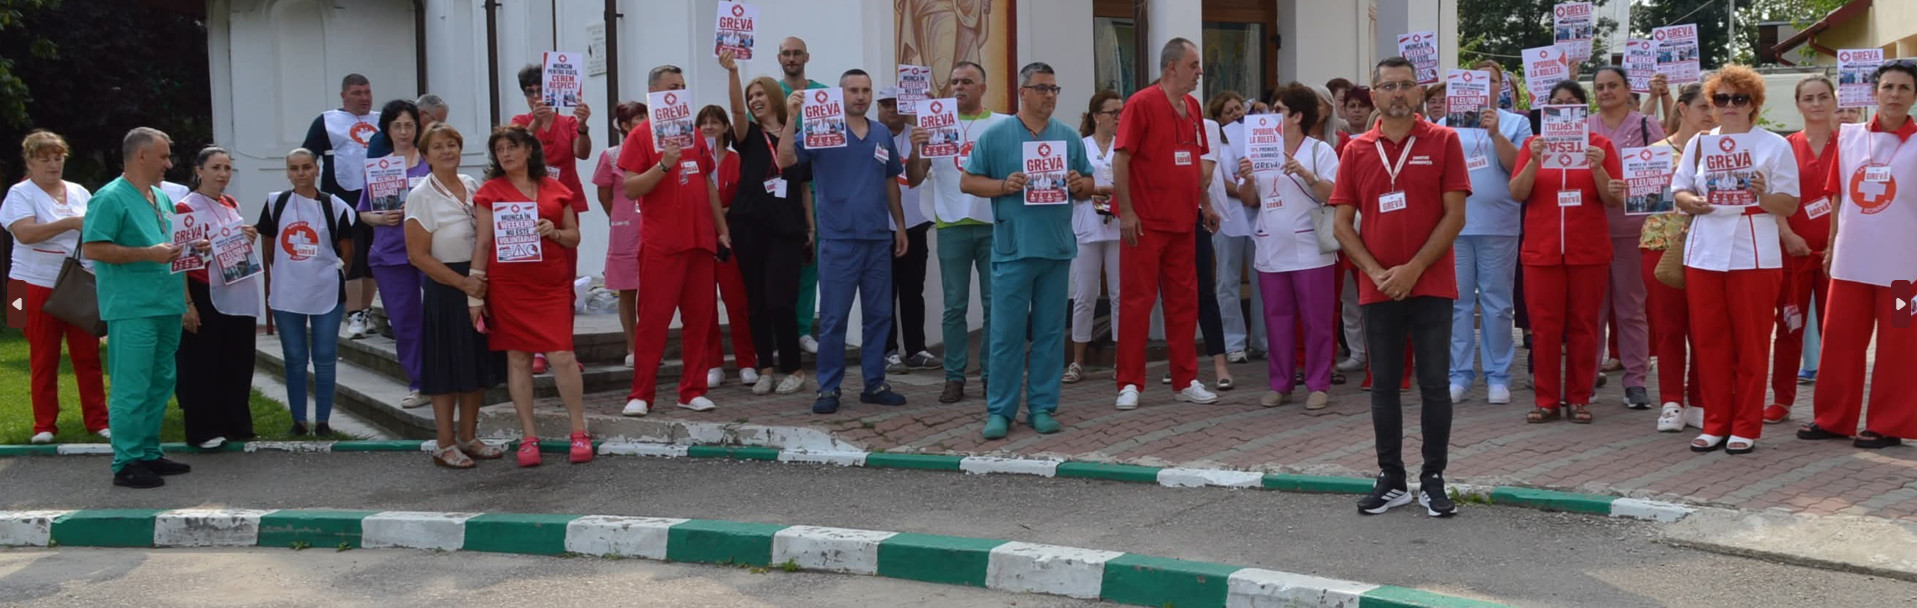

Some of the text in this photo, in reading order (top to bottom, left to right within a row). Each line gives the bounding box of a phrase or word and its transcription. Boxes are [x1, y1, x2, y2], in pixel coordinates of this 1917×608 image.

[720, 16, 753, 30] GREVĂ
[655, 102, 690, 120] GREVĂ
[805, 100, 840, 118] GREVĂ
[921, 111, 955, 128] GREVĂ
[1027, 154, 1064, 172] GREVĂ
[1706, 149, 1752, 170] GREVĂ
[1635, 176, 1668, 188] LEI/ORĂ?
[501, 213, 524, 221] MUNCA
[175, 224, 202, 242] GREVĂ
